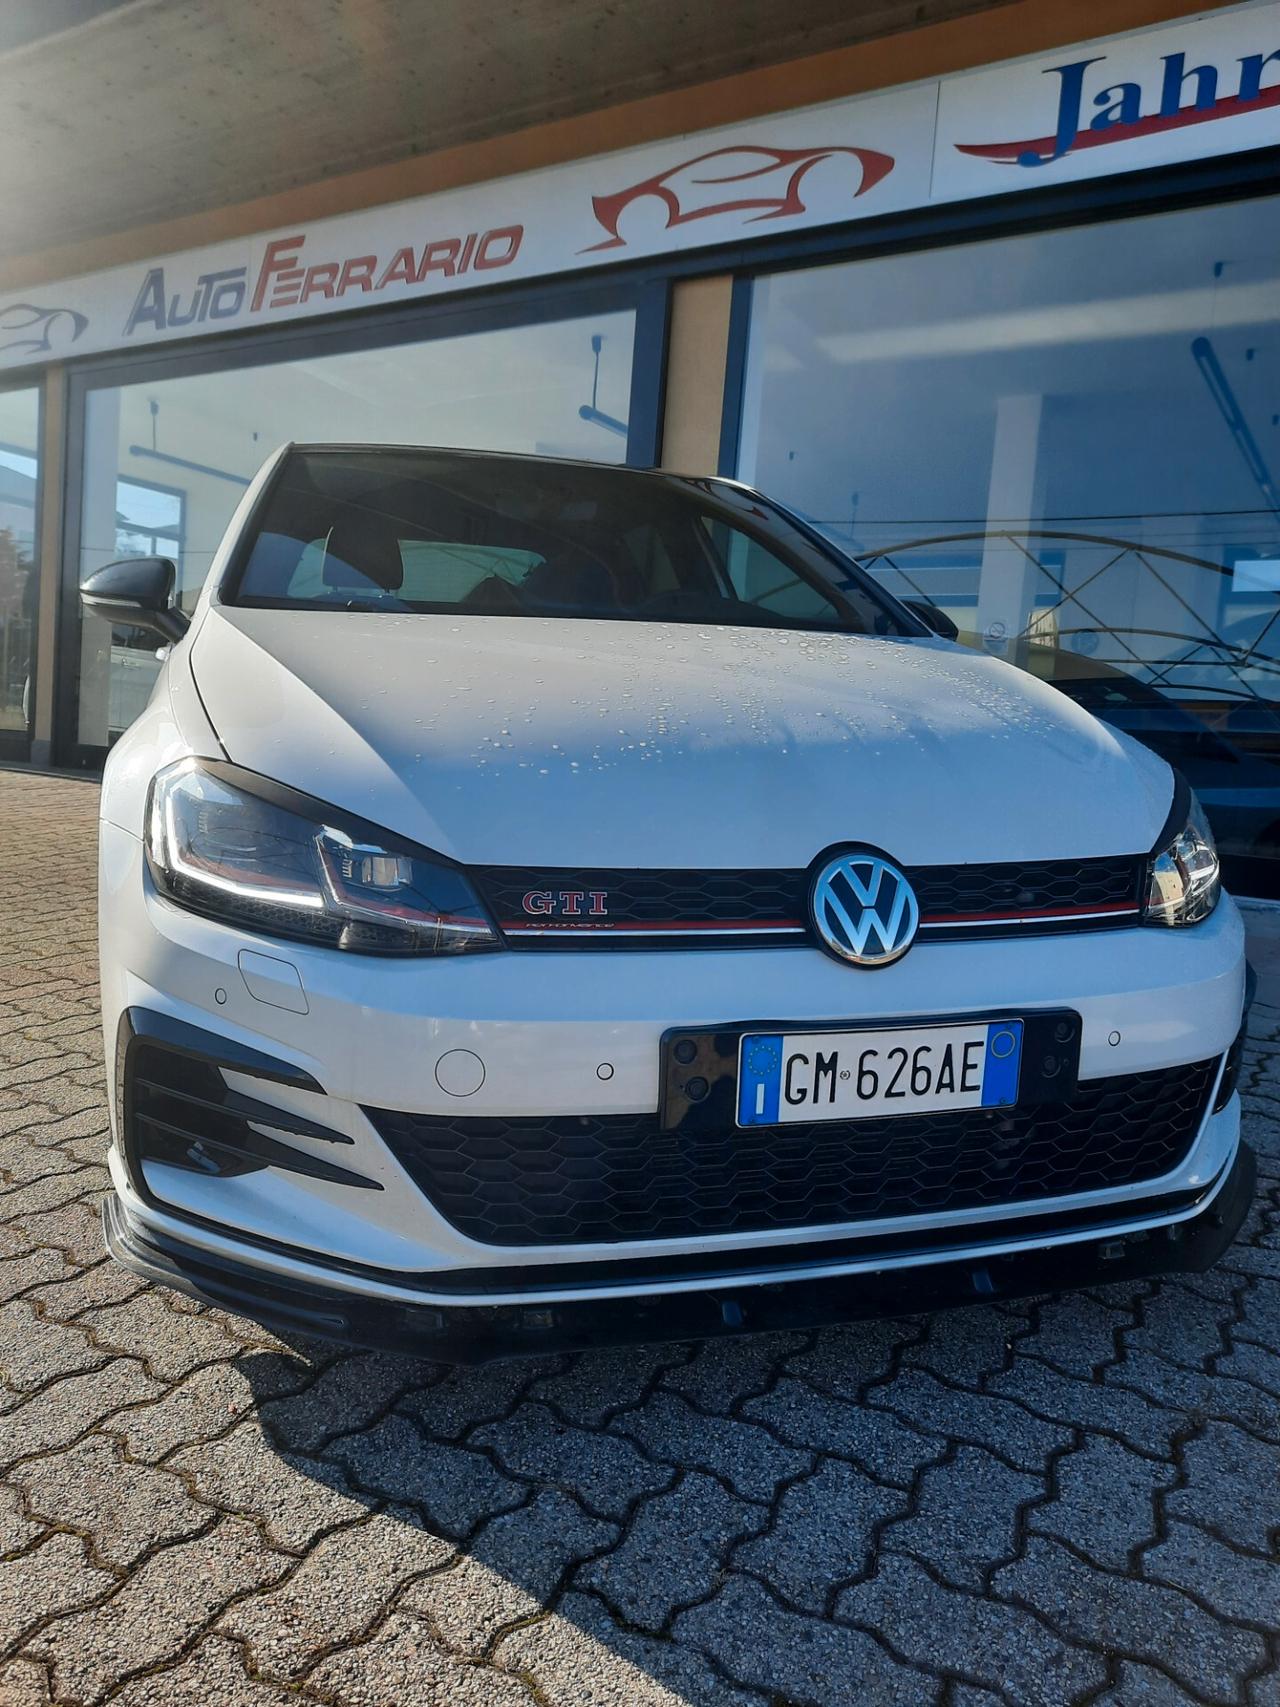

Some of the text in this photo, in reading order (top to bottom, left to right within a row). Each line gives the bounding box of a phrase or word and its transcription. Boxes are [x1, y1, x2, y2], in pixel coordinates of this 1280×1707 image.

[1017, 49, 1280, 168] Jahr
[249, 224, 524, 312] FERRARIO
[521, 890, 608, 915] GTI
[784, 1051, 839, 1105] GM
[856, 1041, 984, 1100] 626AE
